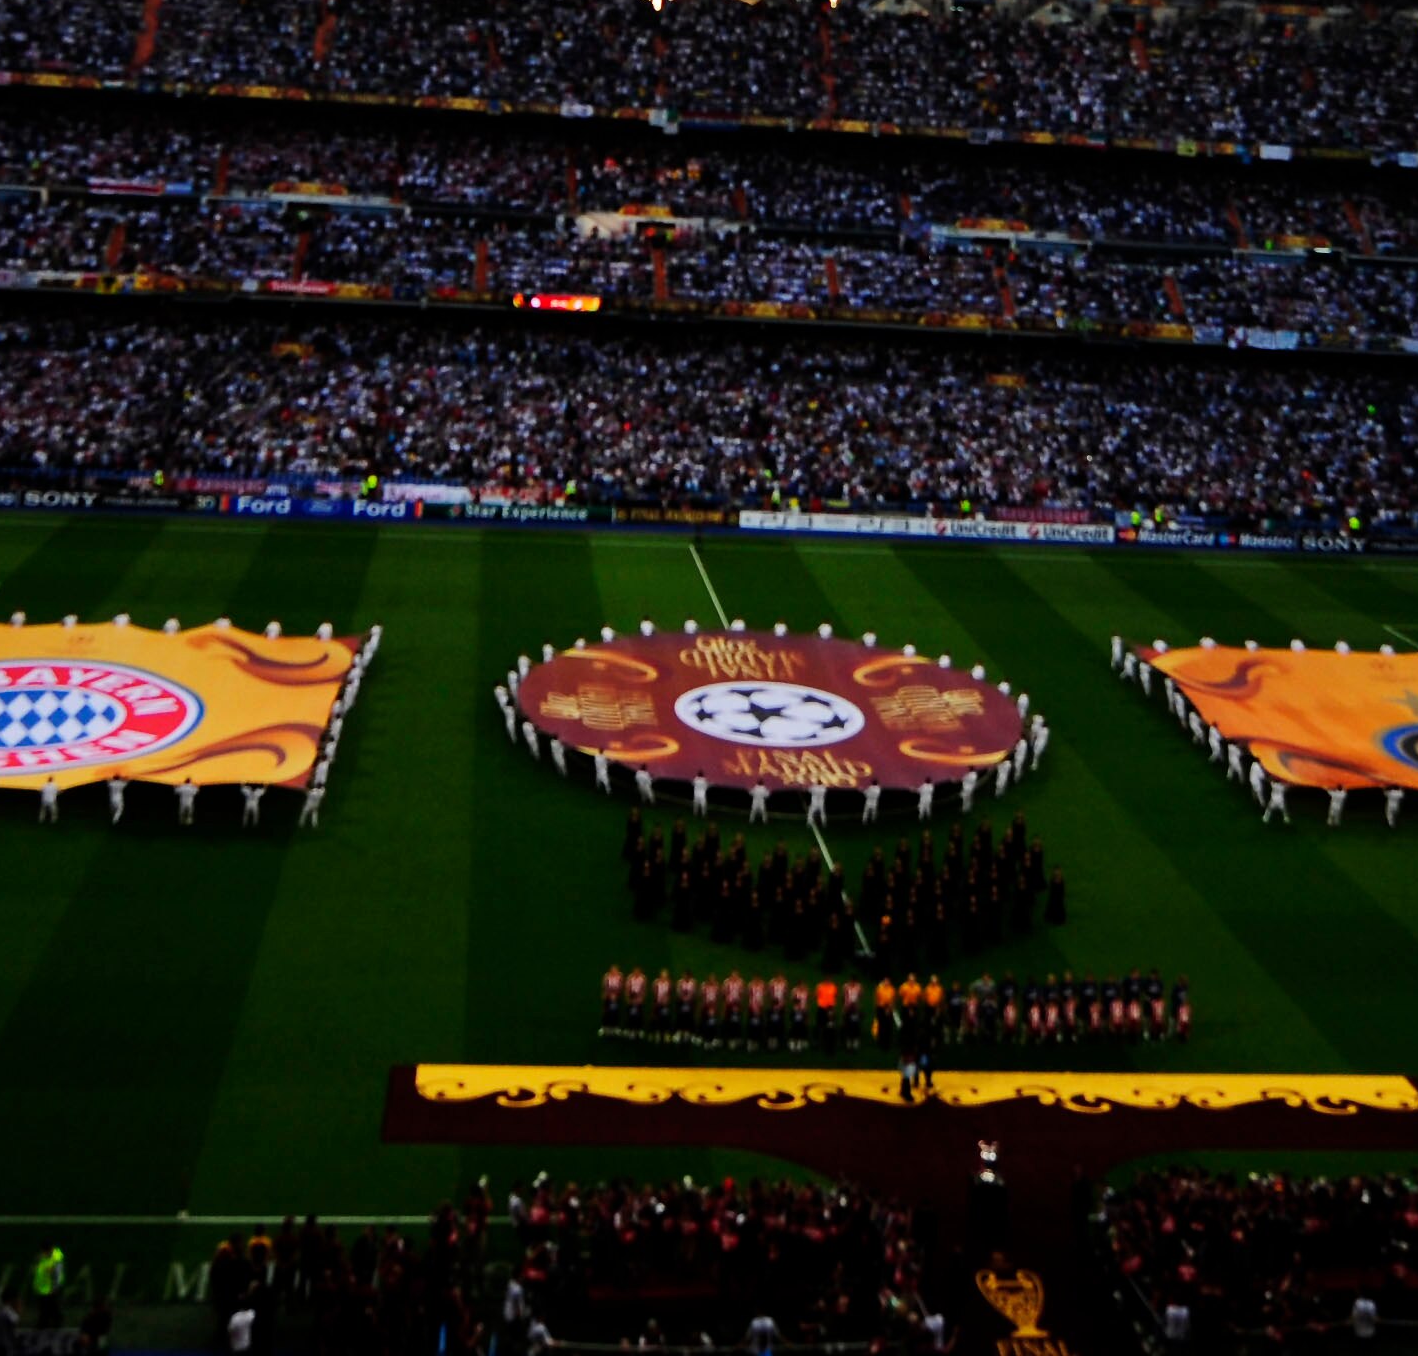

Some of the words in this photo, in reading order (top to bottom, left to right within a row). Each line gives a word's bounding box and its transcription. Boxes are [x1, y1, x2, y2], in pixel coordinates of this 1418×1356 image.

[23, 490, 98, 508] SONY
[235, 496, 293, 516] Ford
[352, 499, 408, 519] Ford
[1043, 524, 1110, 542] UniCredit
